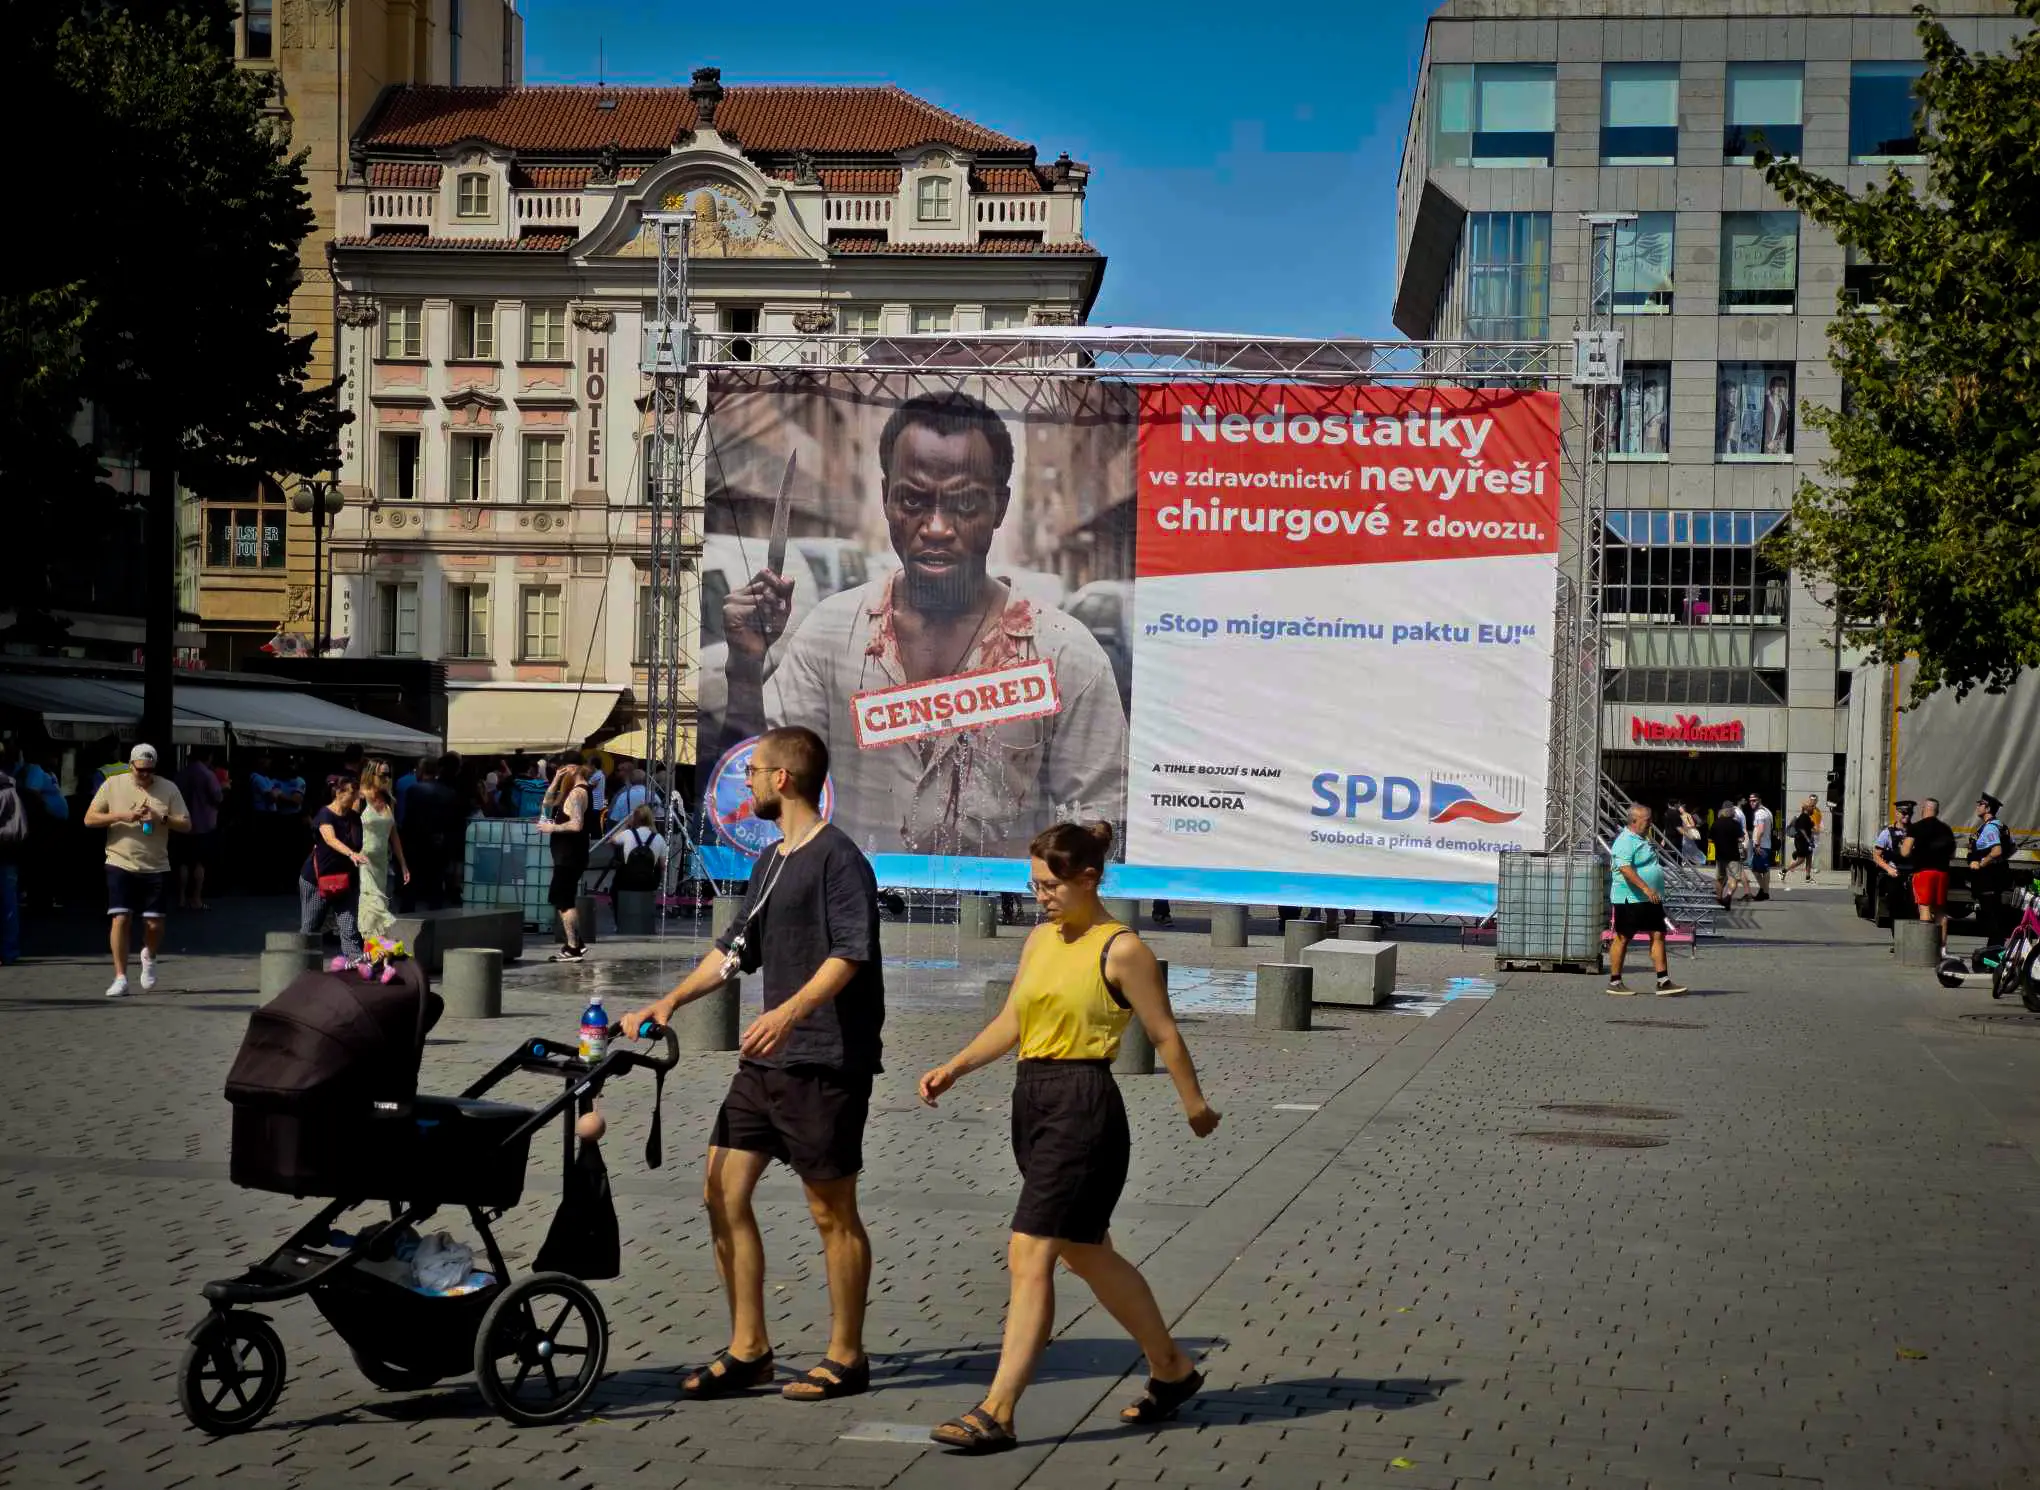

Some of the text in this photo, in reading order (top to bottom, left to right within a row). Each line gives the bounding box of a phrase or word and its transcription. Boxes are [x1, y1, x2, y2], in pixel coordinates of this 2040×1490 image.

[586, 347, 604, 482] HOTEL
[1181, 404, 1494, 457] Nedostatky
[1150, 459, 1548, 500] ve zdravotnictví nevyřeší
[1157, 497, 1545, 541] chirurgové z dovozu.
[343, 591, 351, 635] HOTE
[1226, 614, 1384, 640] migračnímu
[1392, 621, 1469, 645] paktu
[864, 676, 1046, 733] CENSORED
[1152, 764, 1281, 778] A TIHLE BOJUJÍ S NÁMI
[1151, 794, 1245, 810] TRIKOLORA
[1311, 773, 1420, 820] SPD
[1175, 819, 1211, 832] PRO
[1311, 830, 1373, 845] Svoboda
[1377, 837, 1385, 845] a
[1436, 837, 1522, 852] demokracie
